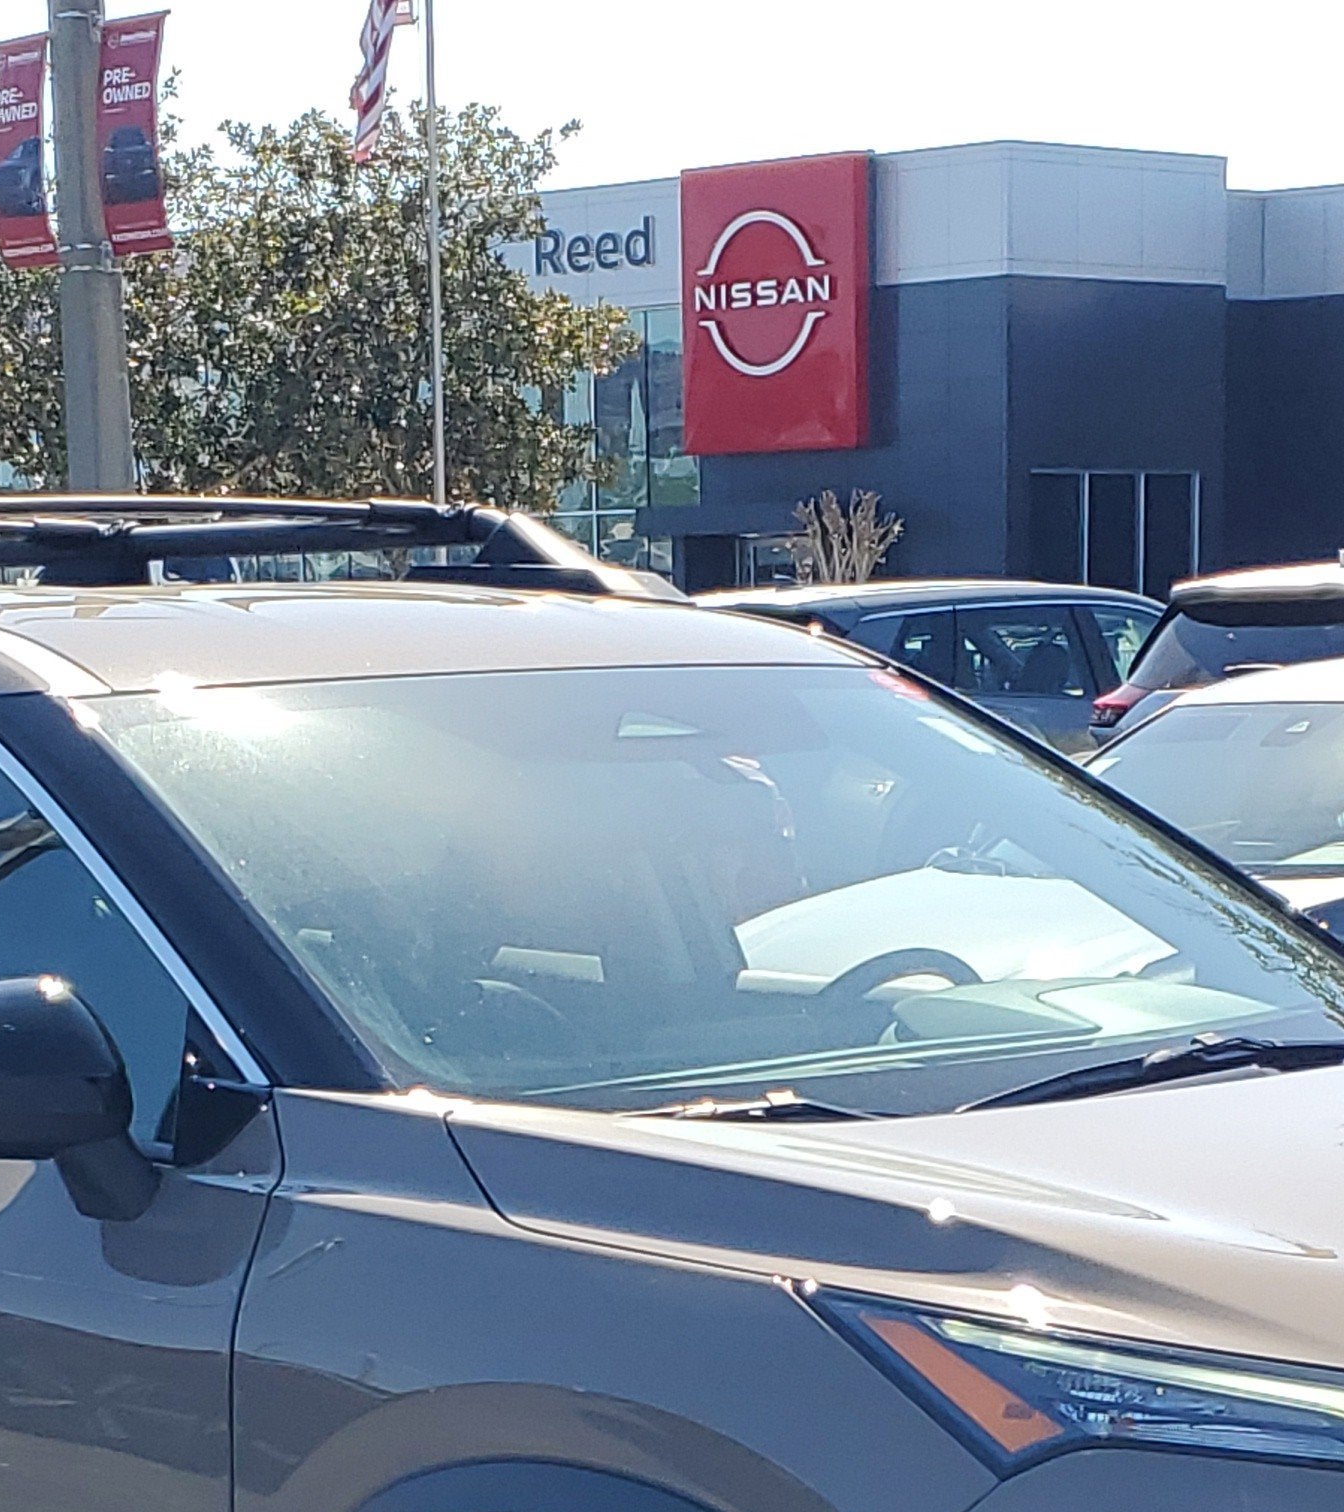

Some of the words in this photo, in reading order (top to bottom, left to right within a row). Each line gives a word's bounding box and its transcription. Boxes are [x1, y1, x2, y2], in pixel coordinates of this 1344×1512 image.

[103, 66, 135, 86] PRE-
[103, 82, 151, 104] OWNED
[534, 215, 655, 276] Reed
[694, 274, 830, 312] NISSAN
